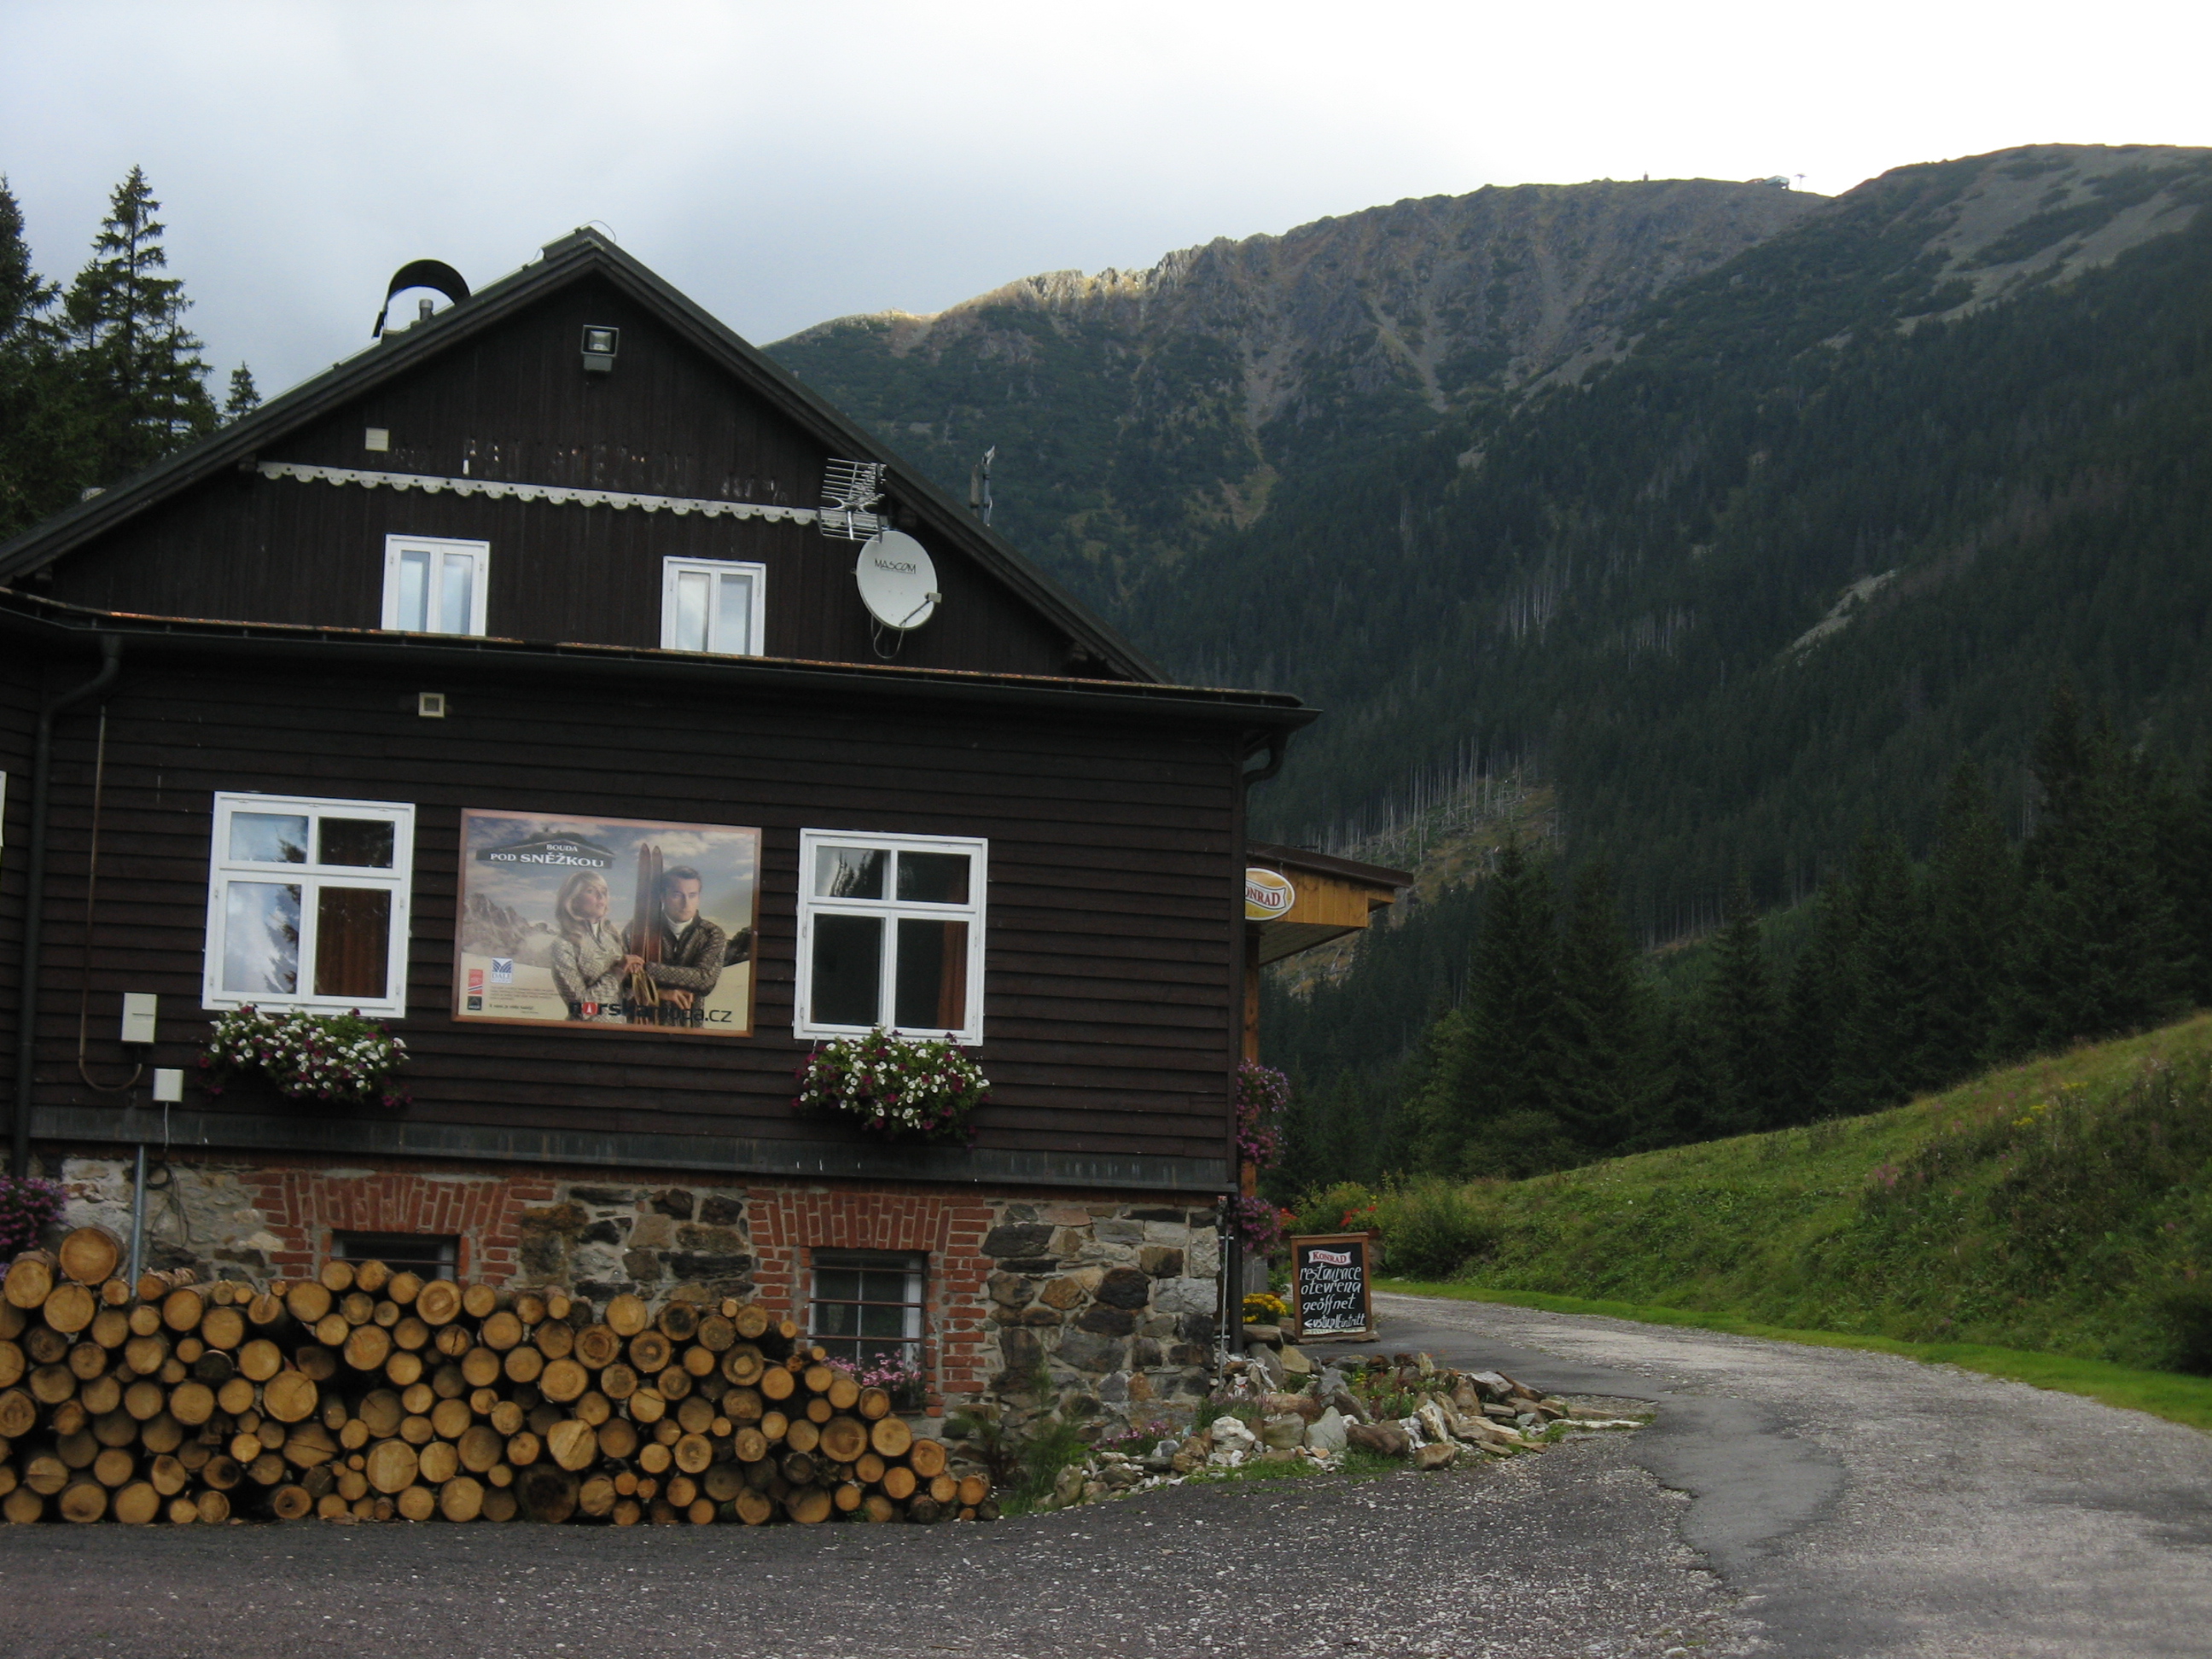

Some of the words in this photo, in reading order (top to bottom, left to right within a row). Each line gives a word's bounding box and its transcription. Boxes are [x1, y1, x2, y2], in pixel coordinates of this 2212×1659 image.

[874, 558, 917, 574] MASCOM
[546, 844, 578, 853] BOUDA
[490, 853, 516, 862] POD
[520, 852, 604, 868] SNĚŽKOU
[1313, 1252, 1347, 1263] KONRAD
[1300, 1262, 1361, 1280] restaurace
[1302, 1294, 1355, 1314] geöffnet
